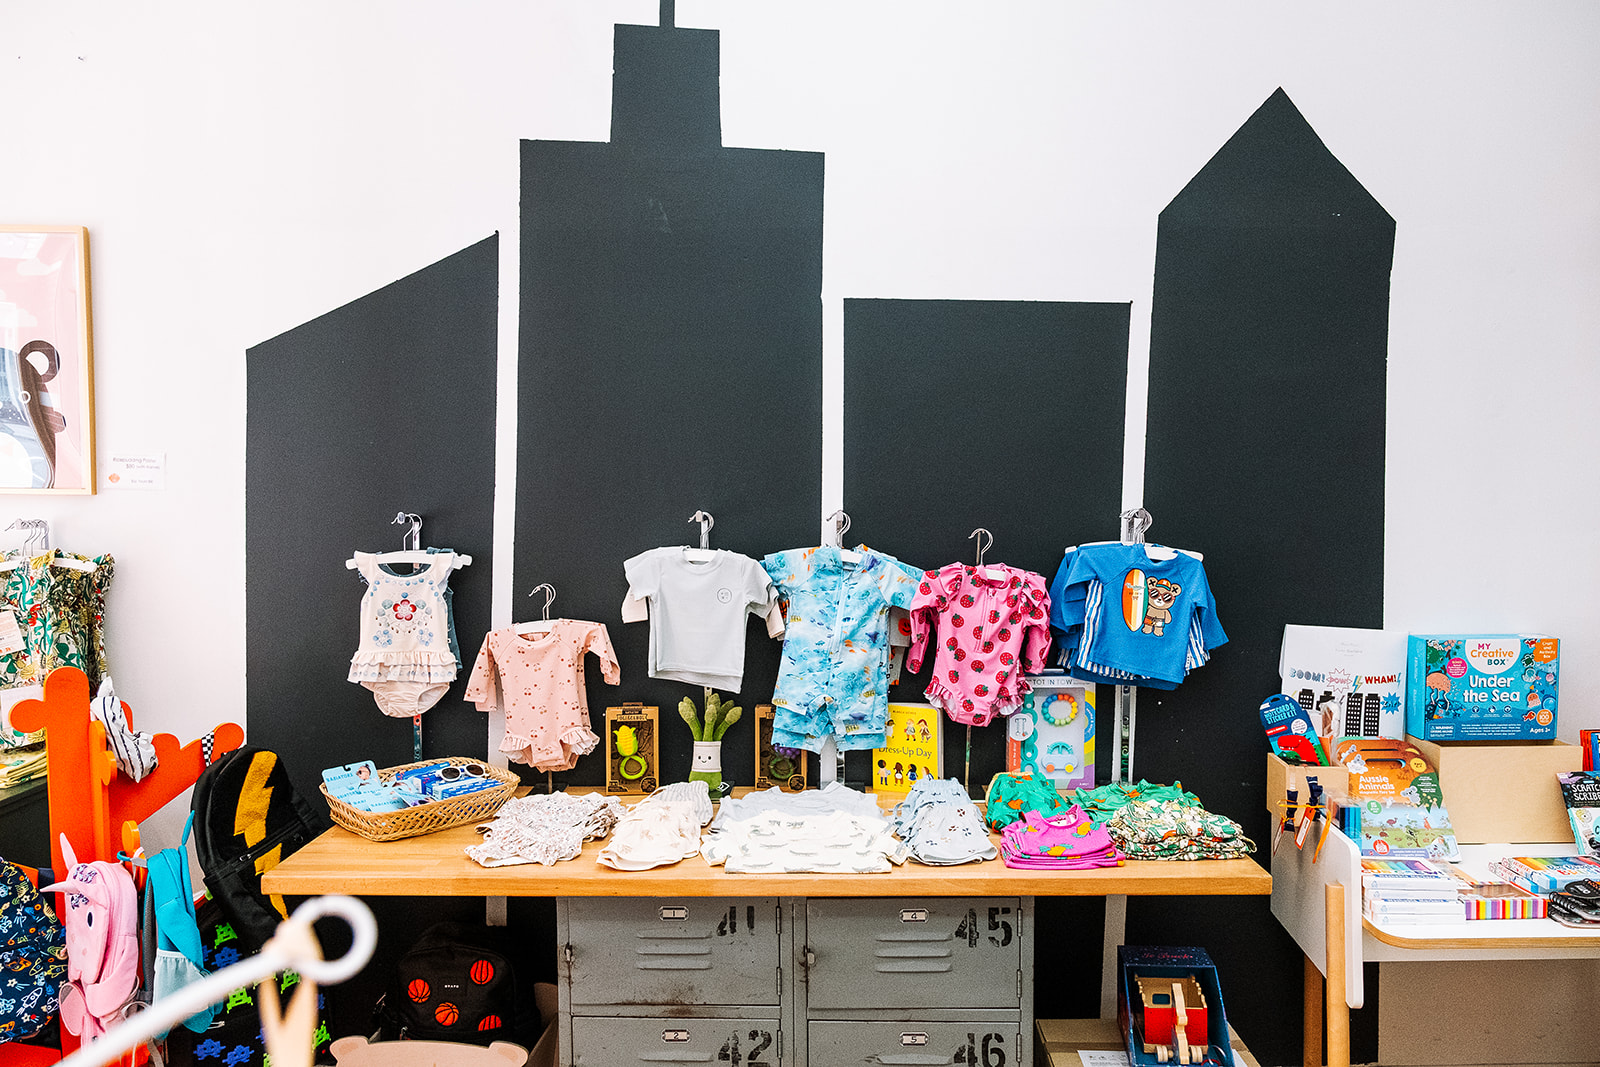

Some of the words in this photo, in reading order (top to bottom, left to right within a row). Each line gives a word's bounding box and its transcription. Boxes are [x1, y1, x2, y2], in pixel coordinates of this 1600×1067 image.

[1470, 647, 1514, 659] Creative
[1289, 667, 1326, 683] BOOM!
[1364, 674, 1396, 684] WHAM!
[1469, 675, 1515, 689] Under
[1463, 689, 1489, 703] the
[1492, 689, 1520, 702] Sea
[879, 746, 914, 757] Dress-Up
[916, 747, 932, 759] Day
[1359, 775, 1389, 783] Aussie
[1358, 782, 1395, 791] Animals
[910, 912, 917, 920] 4
[954, 907, 1013, 948] 45
[673, 1031, 679, 1040] 2
[717, 1029, 773, 1067] 42
[953, 1032, 1006, 1067] 46
